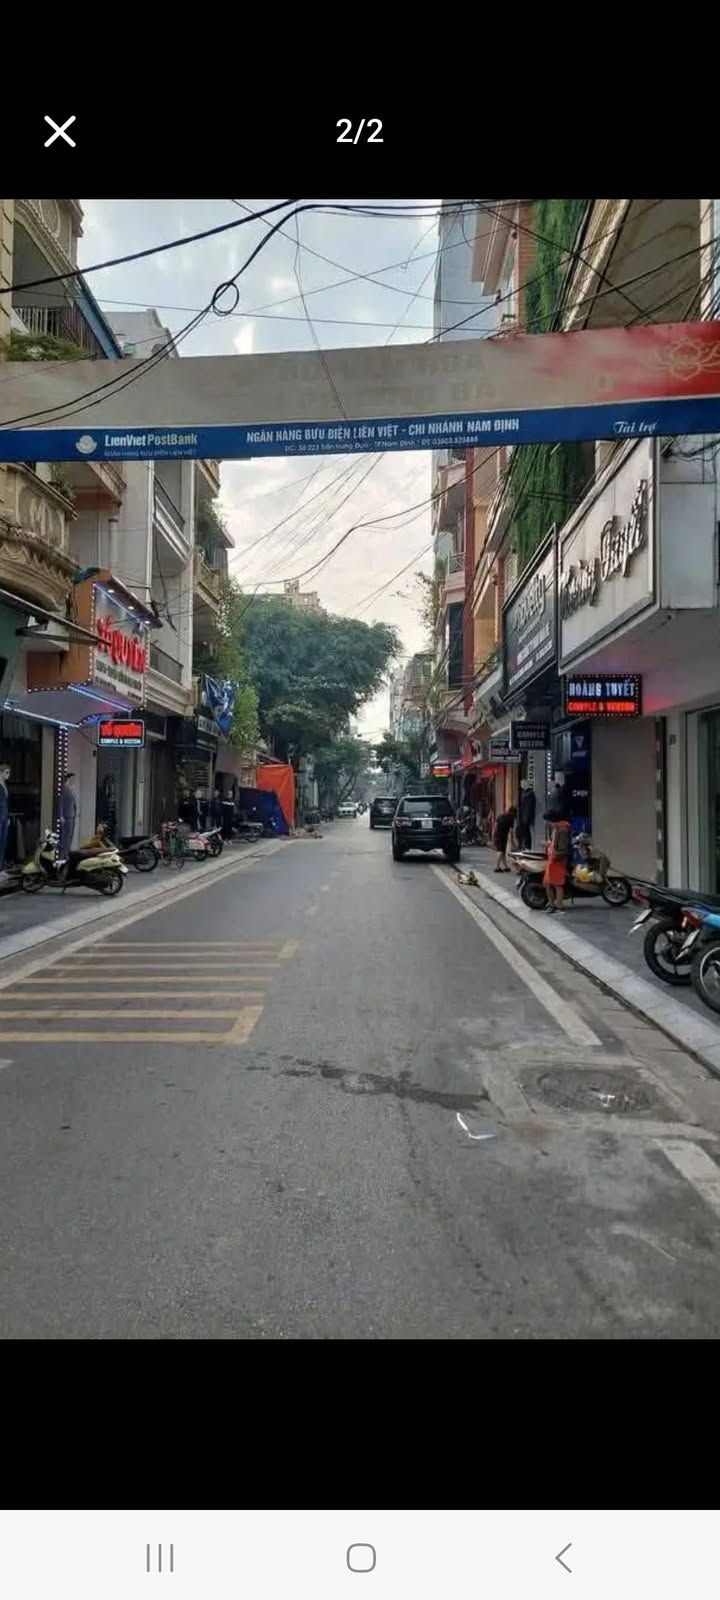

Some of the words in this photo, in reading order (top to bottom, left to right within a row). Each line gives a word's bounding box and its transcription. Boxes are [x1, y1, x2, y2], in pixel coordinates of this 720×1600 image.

[104, 433, 198, 447] LienVietPostBank
[246, 430, 273, 444] NGÂN
[275, 428, 302, 442] HÀNG
[305, 427, 325, 440] BƯU
[327, 425, 350, 442] ĐIỆN
[353, 424, 375, 439] LIÊN
[377, 423, 399, 439] VIỆT
[408, 423, 425, 436] CHI
[428, 420, 463, 435] NHÁNH
[466, 419, 491, 433] NAM
[494, 419, 520, 434] ĐỊNH
[569, 680, 602, 697] HOÀNG
[605, 678, 635, 697] TUYẾT
